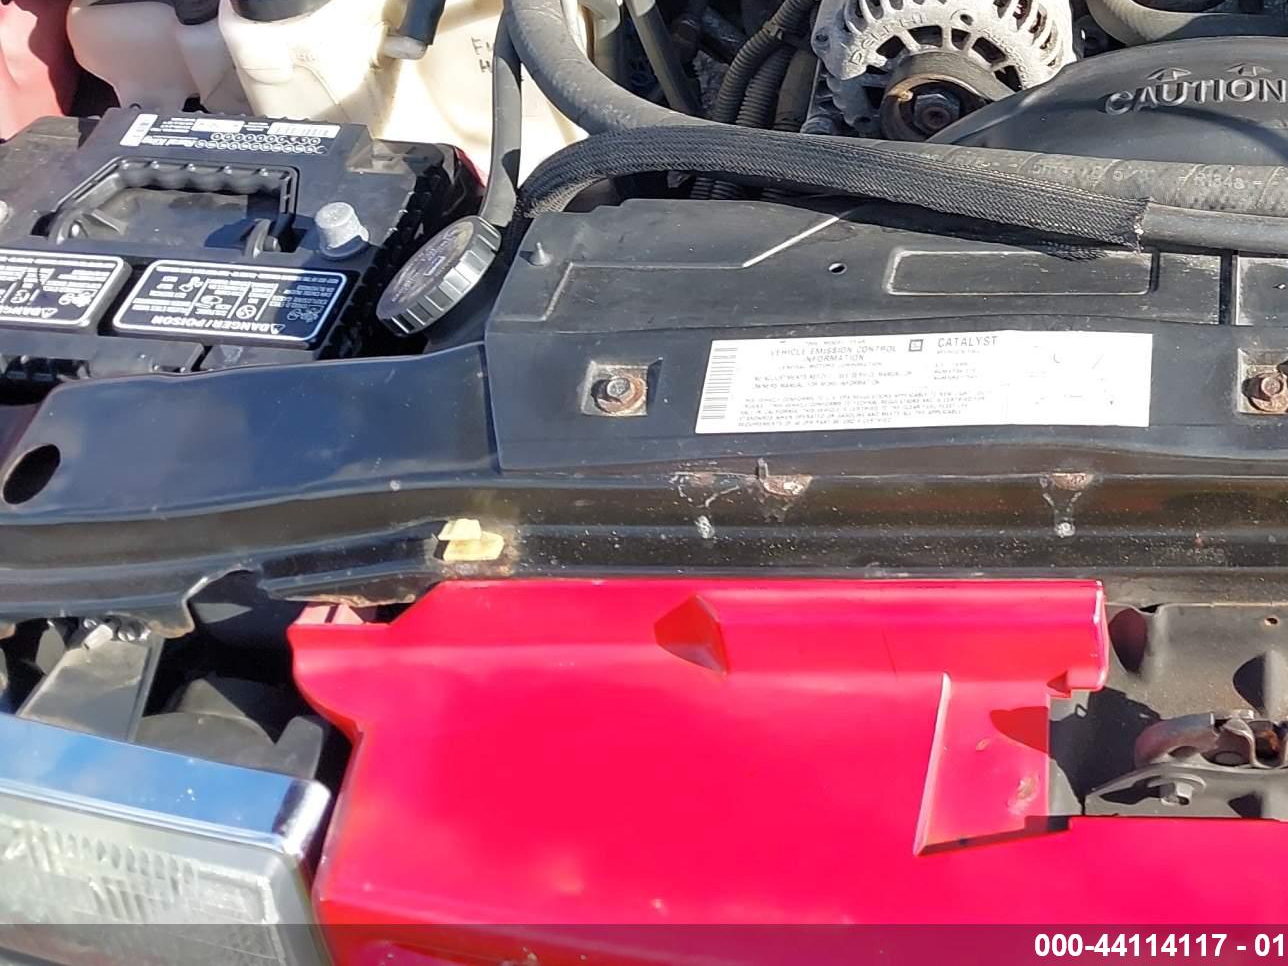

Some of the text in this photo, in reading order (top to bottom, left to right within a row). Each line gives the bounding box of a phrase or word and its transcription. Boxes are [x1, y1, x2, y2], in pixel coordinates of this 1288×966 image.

[938, 335, 998, 348] CATALYST
[770, 345, 897, 357] VEHICLE EMISSION CONTROL
